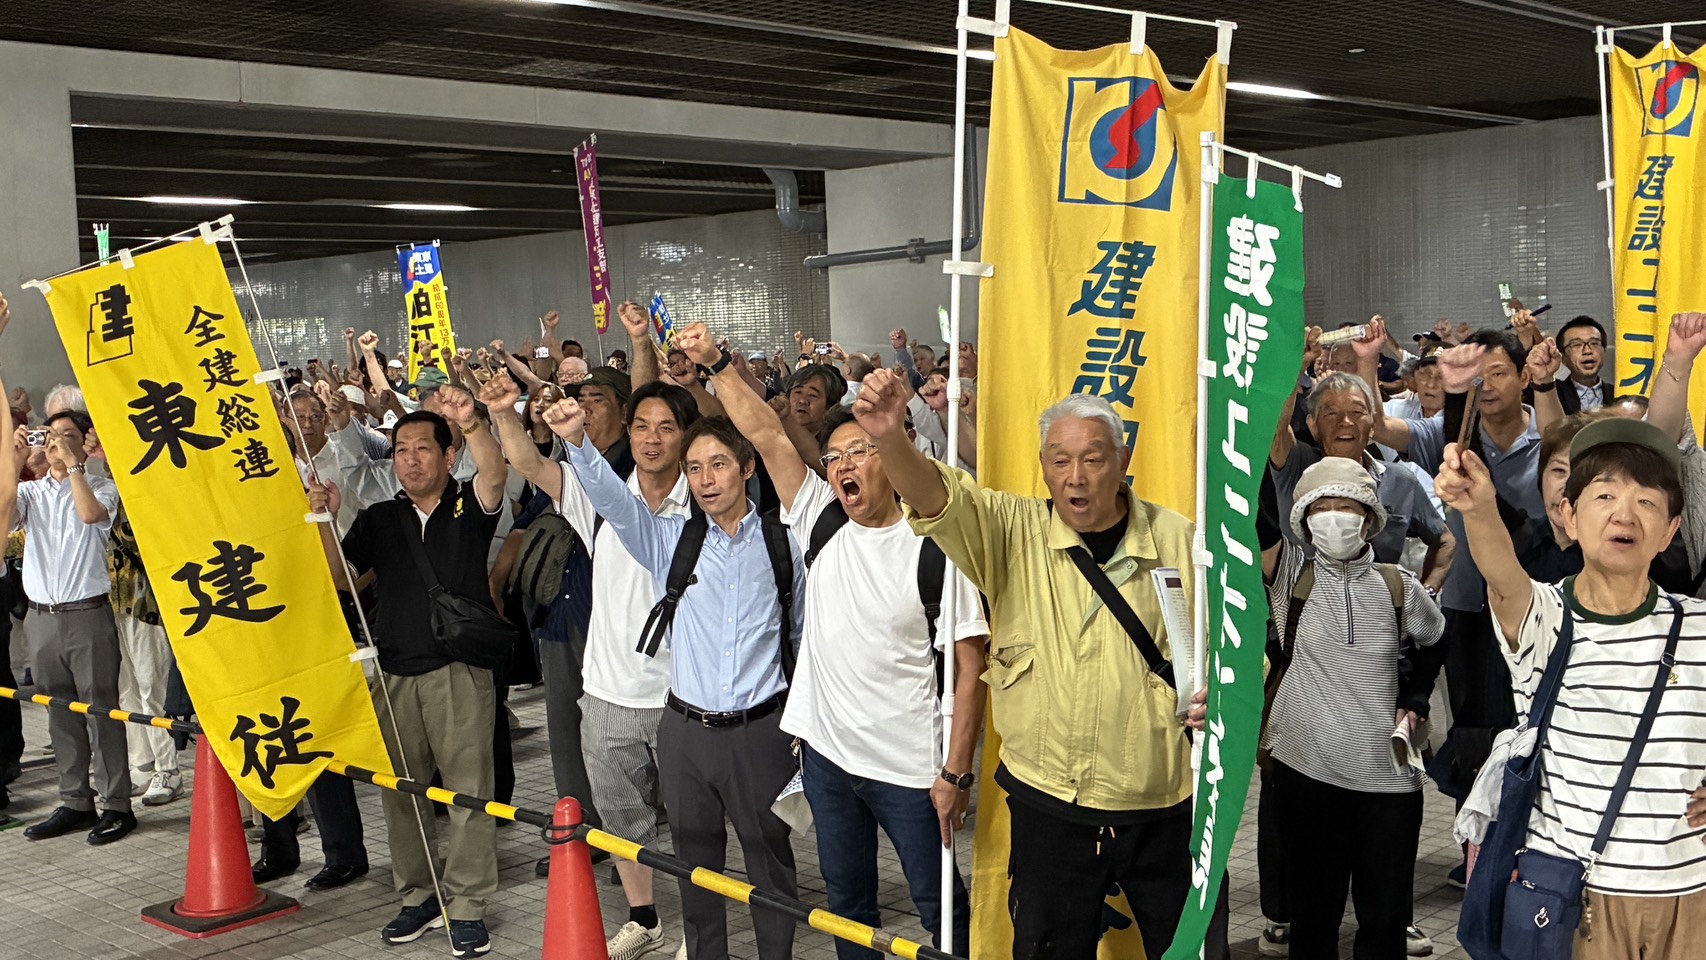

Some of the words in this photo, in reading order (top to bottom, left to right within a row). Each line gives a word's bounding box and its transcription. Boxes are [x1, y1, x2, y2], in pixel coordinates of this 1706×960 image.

[185, 304, 280, 483] 全建総連
[128, 379, 336, 789] 東建従
